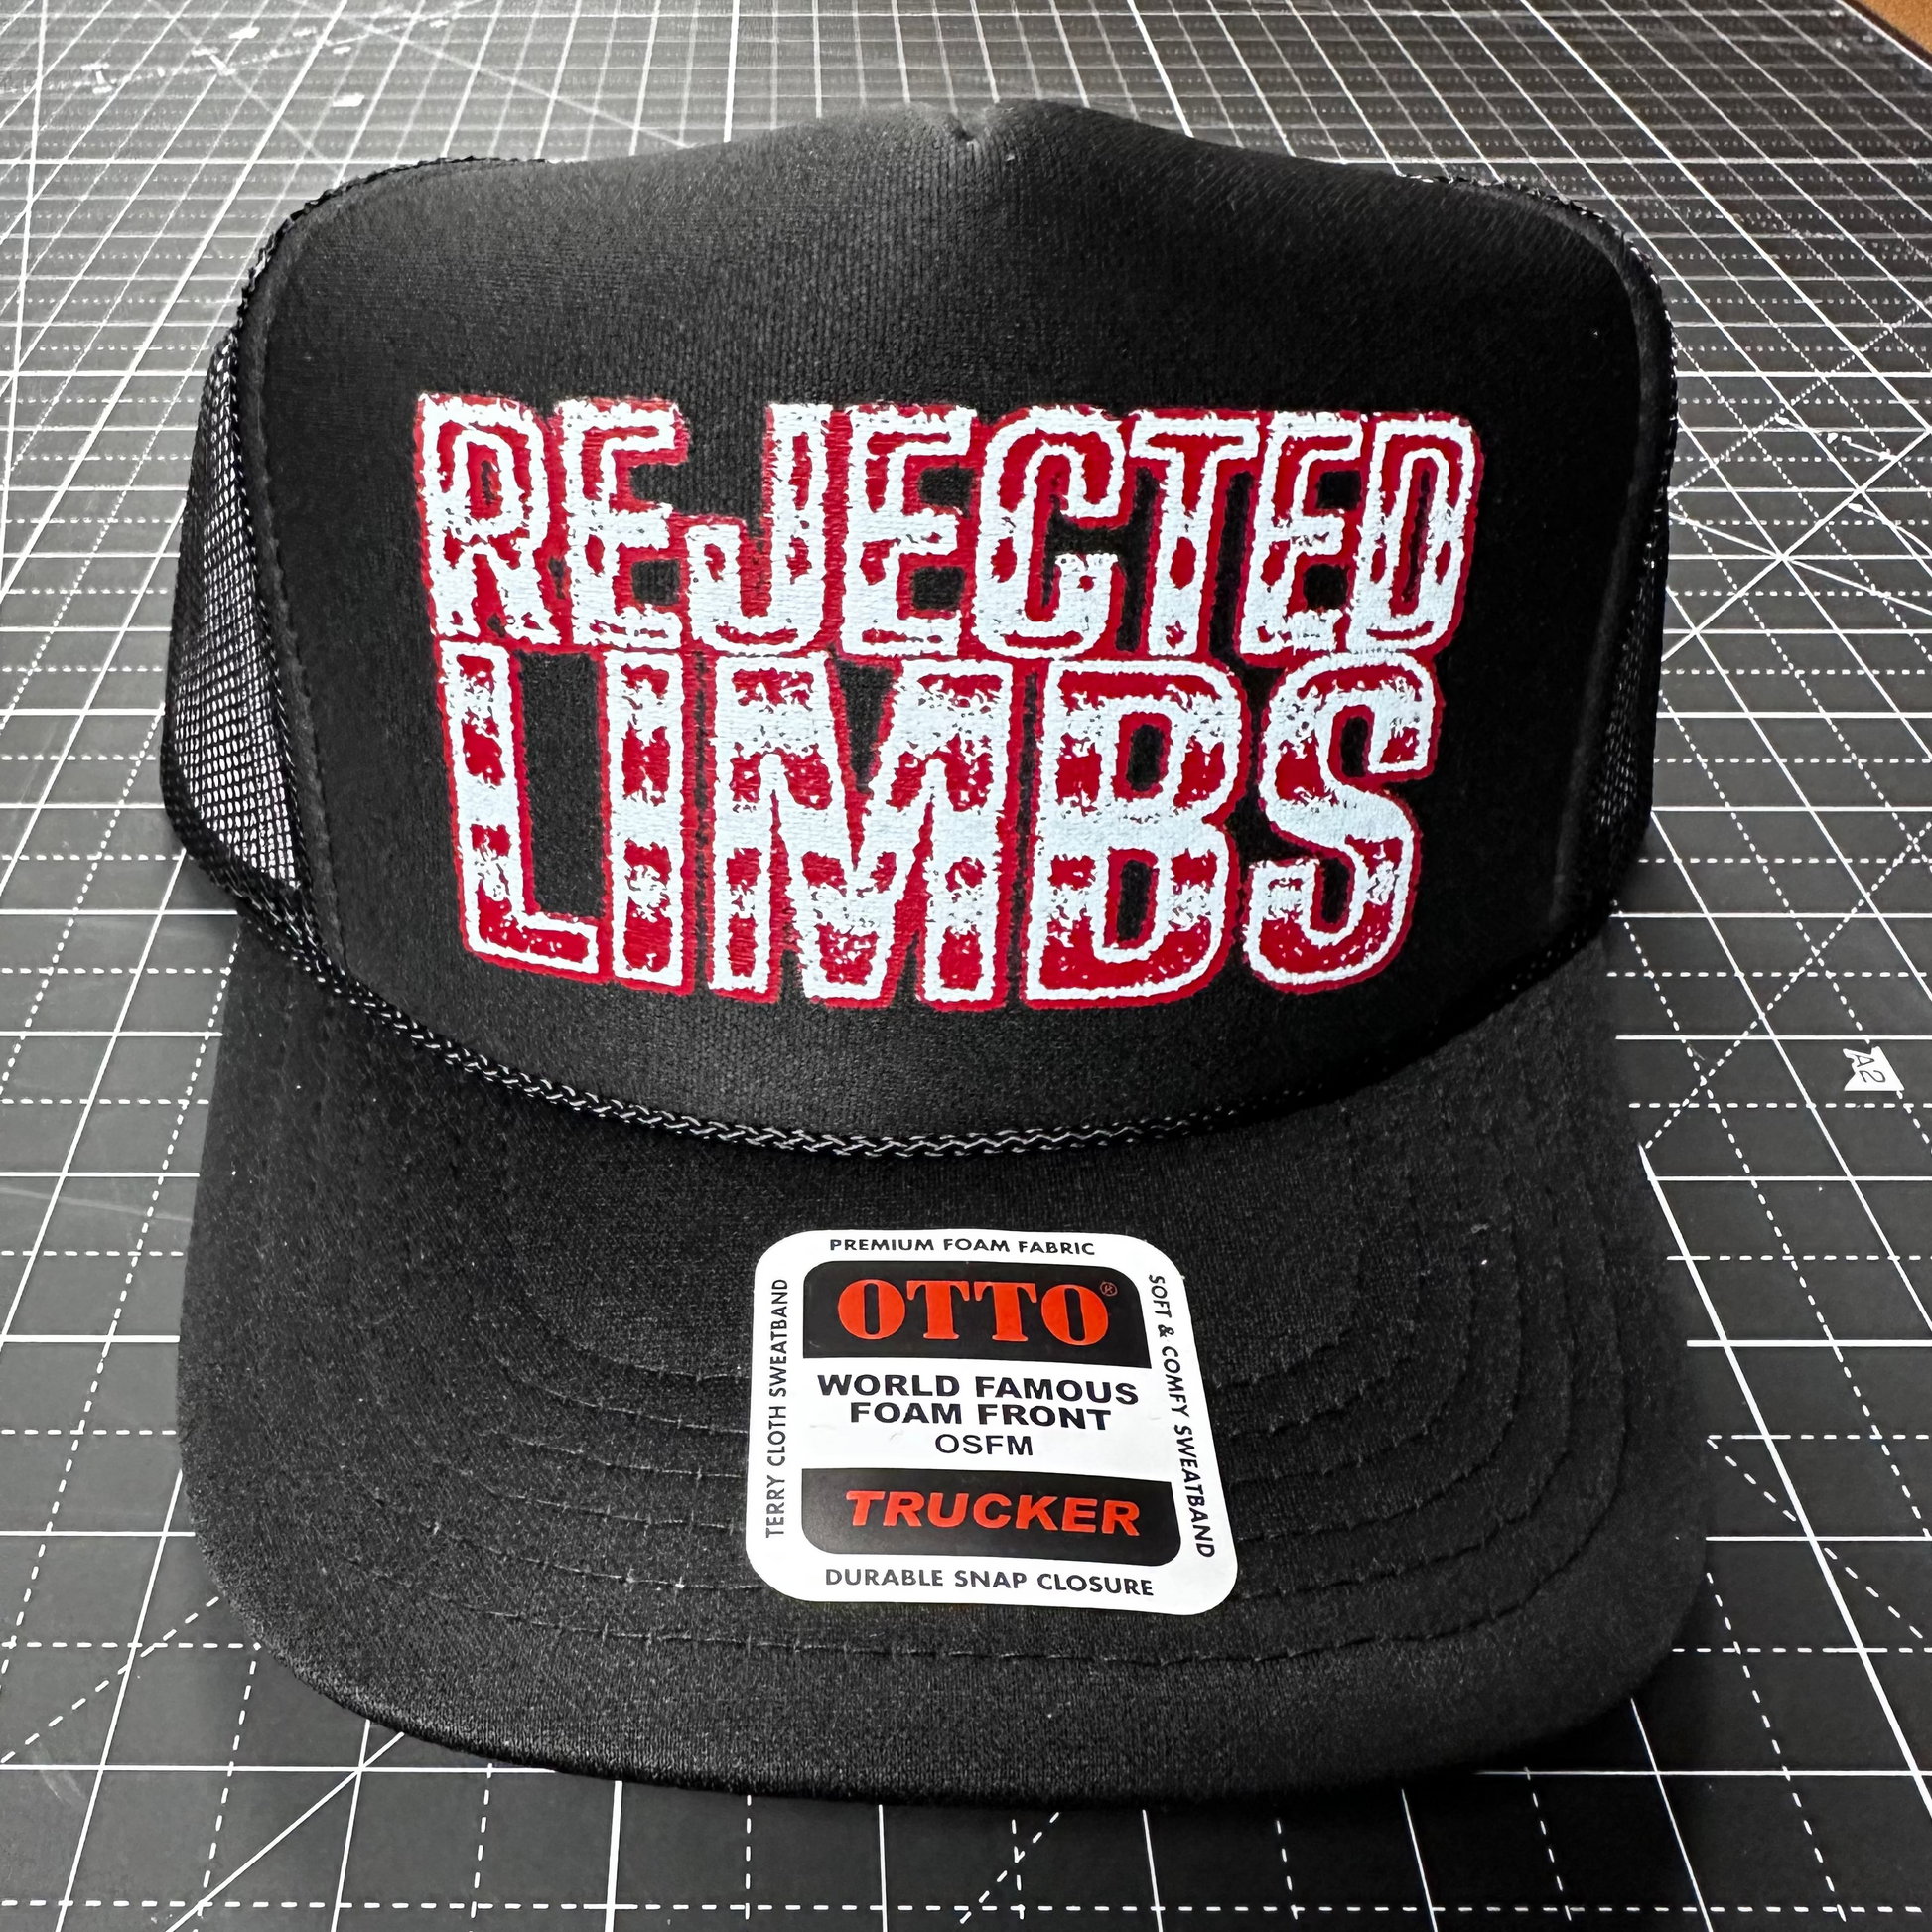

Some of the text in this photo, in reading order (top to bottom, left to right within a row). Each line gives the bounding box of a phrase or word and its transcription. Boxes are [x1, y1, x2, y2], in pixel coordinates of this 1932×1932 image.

[414, 393, 1484, 663] REJECTED
[439, 635, 1442, 1010] LIMBS
[828, 1237, 1097, 1257] PREMIUM FOAM FABRIC
[764, 1277, 790, 1541] TERRY CLOTH SWEATBAND
[816, 1372, 1140, 1406] WORLD FAMOUS
[849, 1401, 1112, 1432] FOAM FRONT
[1148, 1274, 1216, 1558] SOFT & COMFY SWEATBAND
[933, 1432, 1035, 1457] OSFM
[845, 1489, 1141, 1537] TRUCKER
[823, 1567, 1155, 1597] DURABLE SNAP CLOSURE
